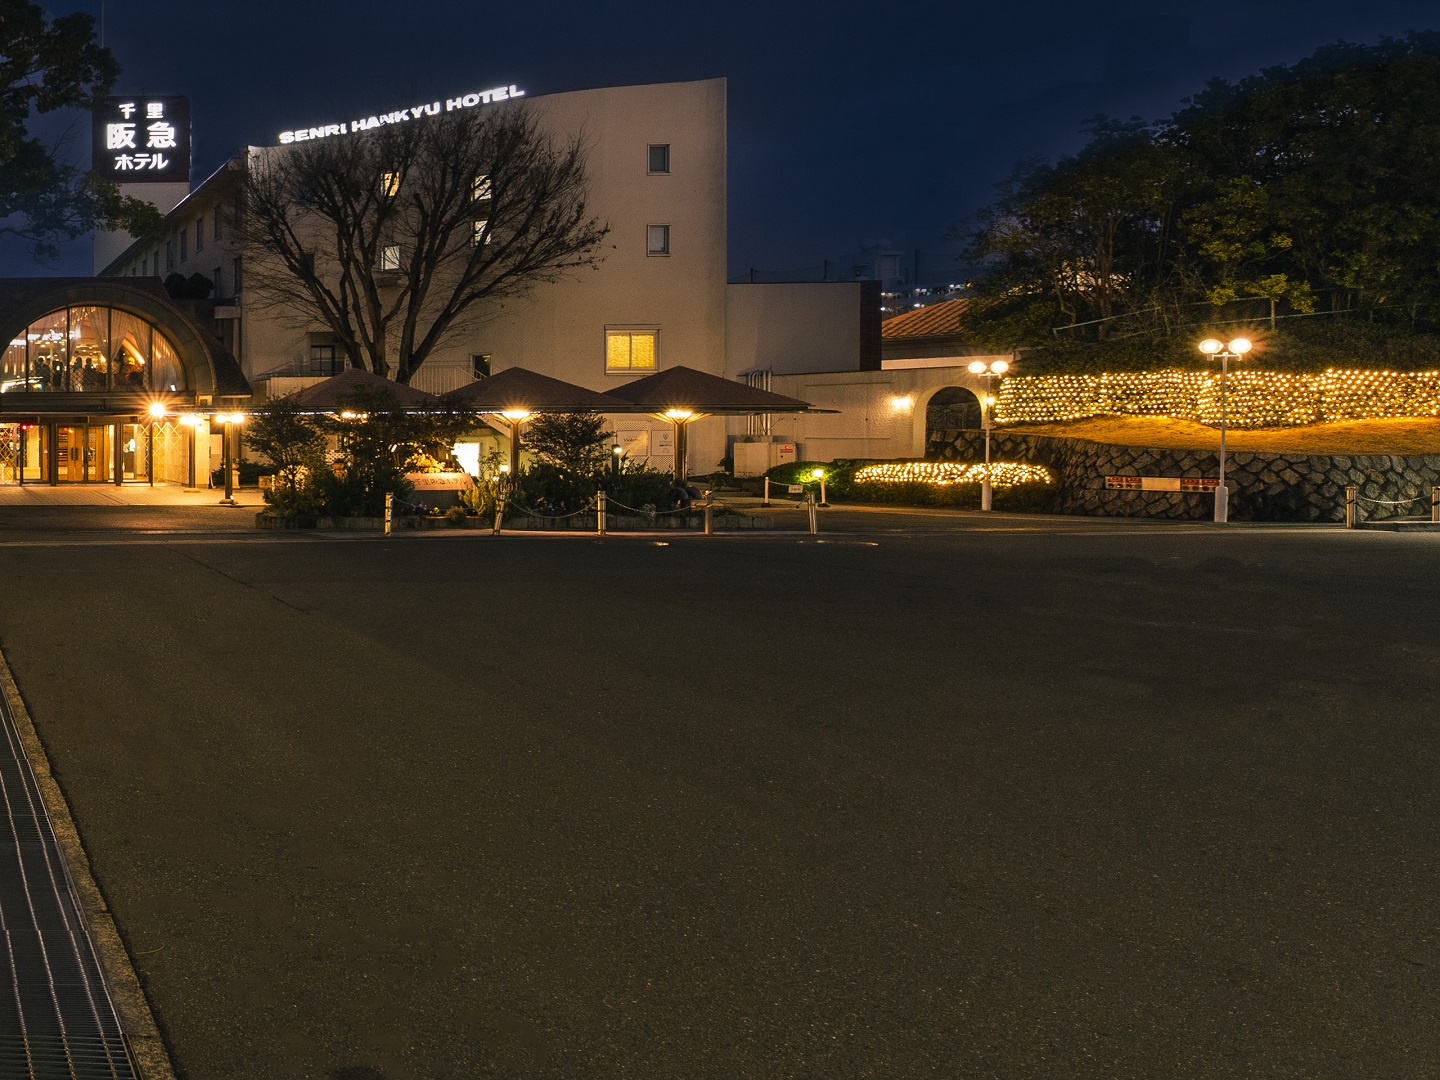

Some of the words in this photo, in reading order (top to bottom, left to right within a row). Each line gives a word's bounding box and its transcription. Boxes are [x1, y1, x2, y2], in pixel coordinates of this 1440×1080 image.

[118, 103, 163, 119] 千里
[279, 123, 347, 144] SENRI
[352, 102, 440, 132] HANKYU
[446, 85, 525, 111] HOTEL
[107, 122, 176, 149] 阪急
[114, 153, 169, 170] ホテル
